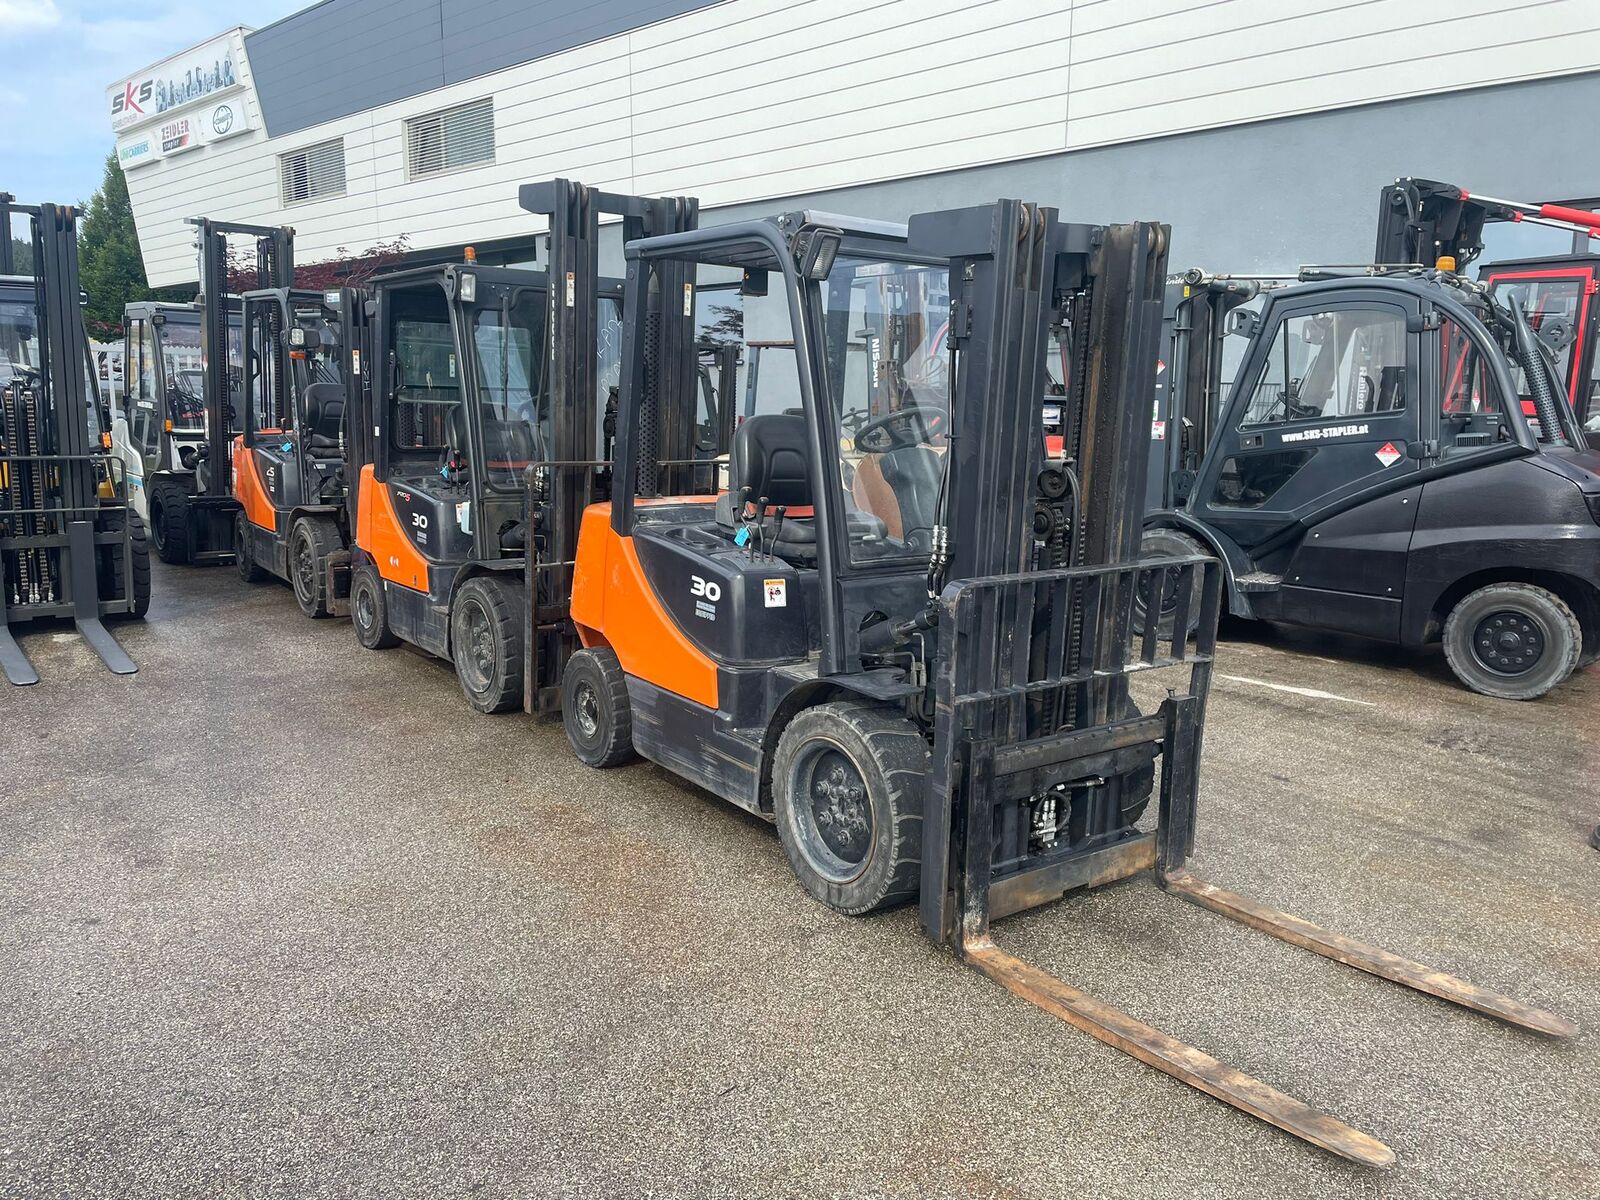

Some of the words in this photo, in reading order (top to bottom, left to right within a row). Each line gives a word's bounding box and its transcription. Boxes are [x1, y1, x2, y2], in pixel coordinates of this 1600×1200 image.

[161, 119, 190, 141] ZEIDLER
[871, 338, 880, 388] NISSAN
[412, 512, 428, 529] 30
[690, 575, 721, 602] 30
